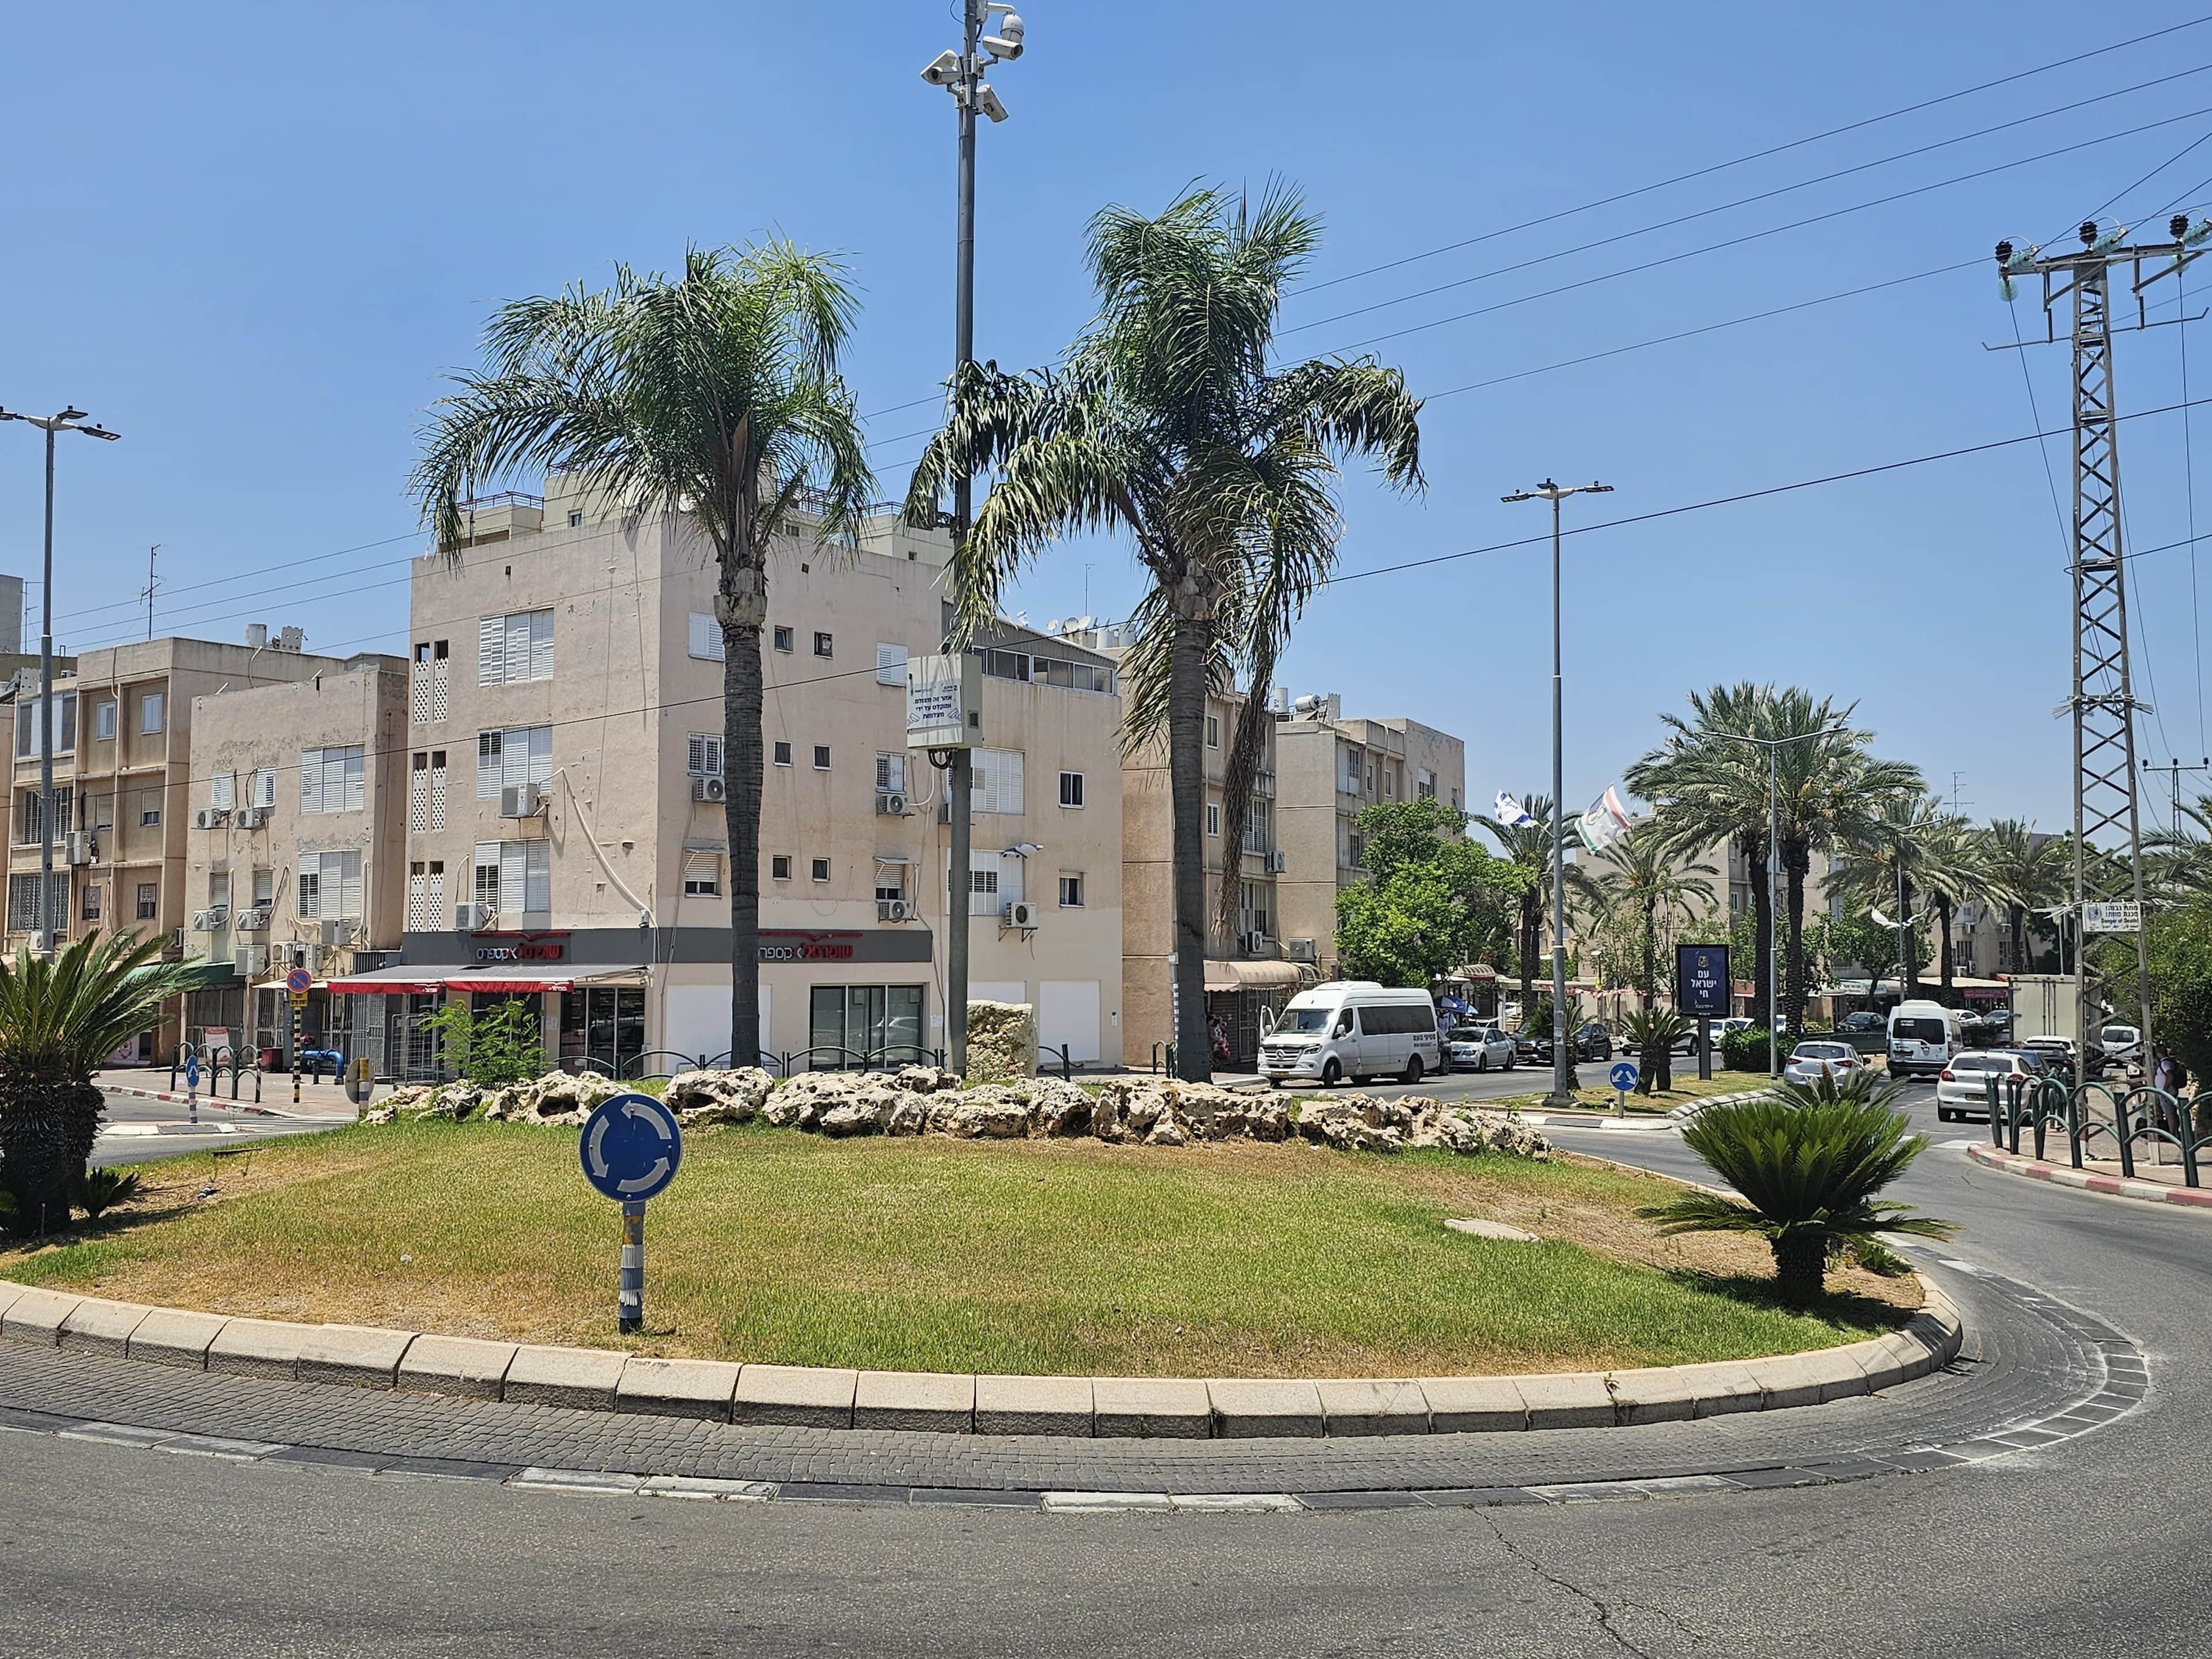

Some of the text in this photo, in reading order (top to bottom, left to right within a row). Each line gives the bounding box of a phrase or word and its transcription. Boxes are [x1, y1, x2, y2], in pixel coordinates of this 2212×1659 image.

[476, 947, 517, 961] אקספרס
[758, 946, 802, 961] אקספר
[1698, 970, 1709, 978] עם
[1691, 979, 1717, 988] ישראל
[1700, 990, 1709, 998] חי
